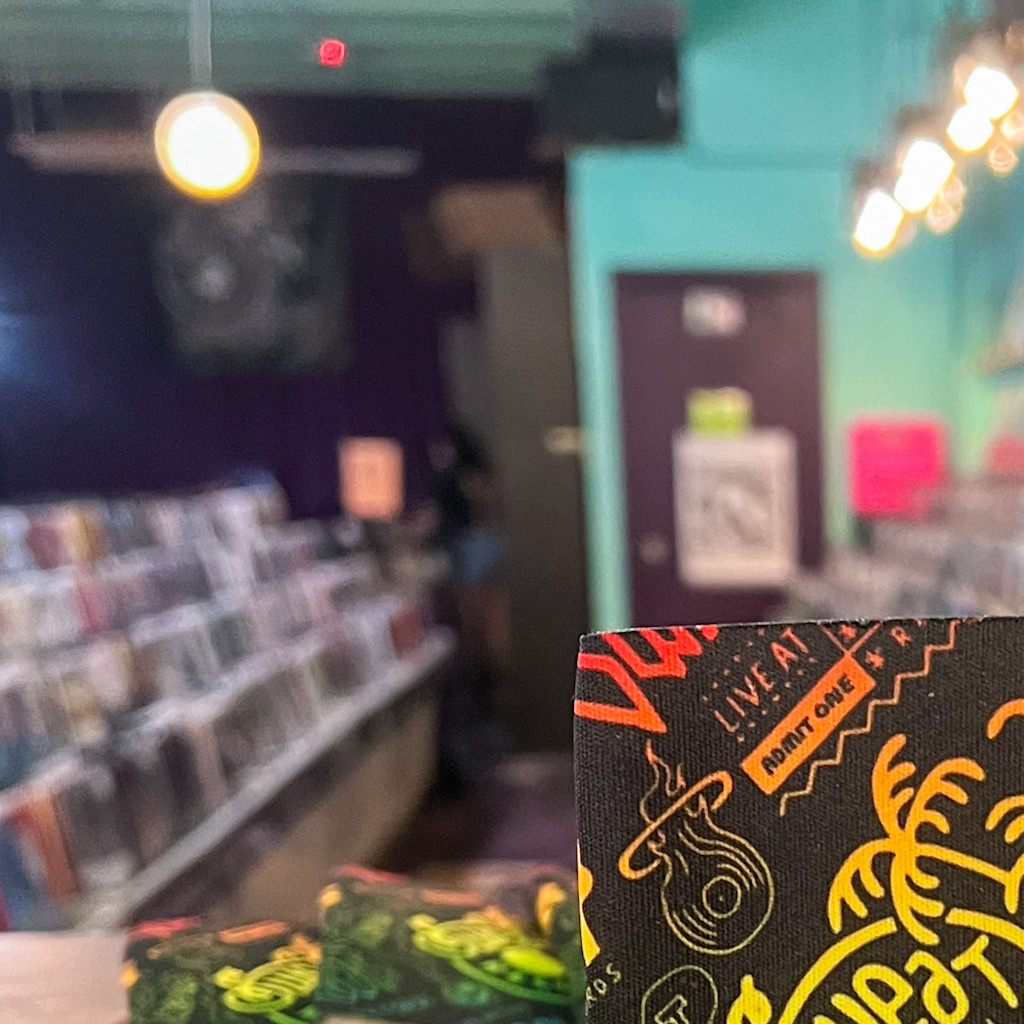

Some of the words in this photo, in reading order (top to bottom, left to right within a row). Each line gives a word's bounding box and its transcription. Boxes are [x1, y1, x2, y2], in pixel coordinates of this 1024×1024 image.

[713, 661, 775, 734] LIVE
[770, 626, 809, 673] AT
[760, 715, 815, 777] ADMIT
[813, 672, 856, 719] ONE
